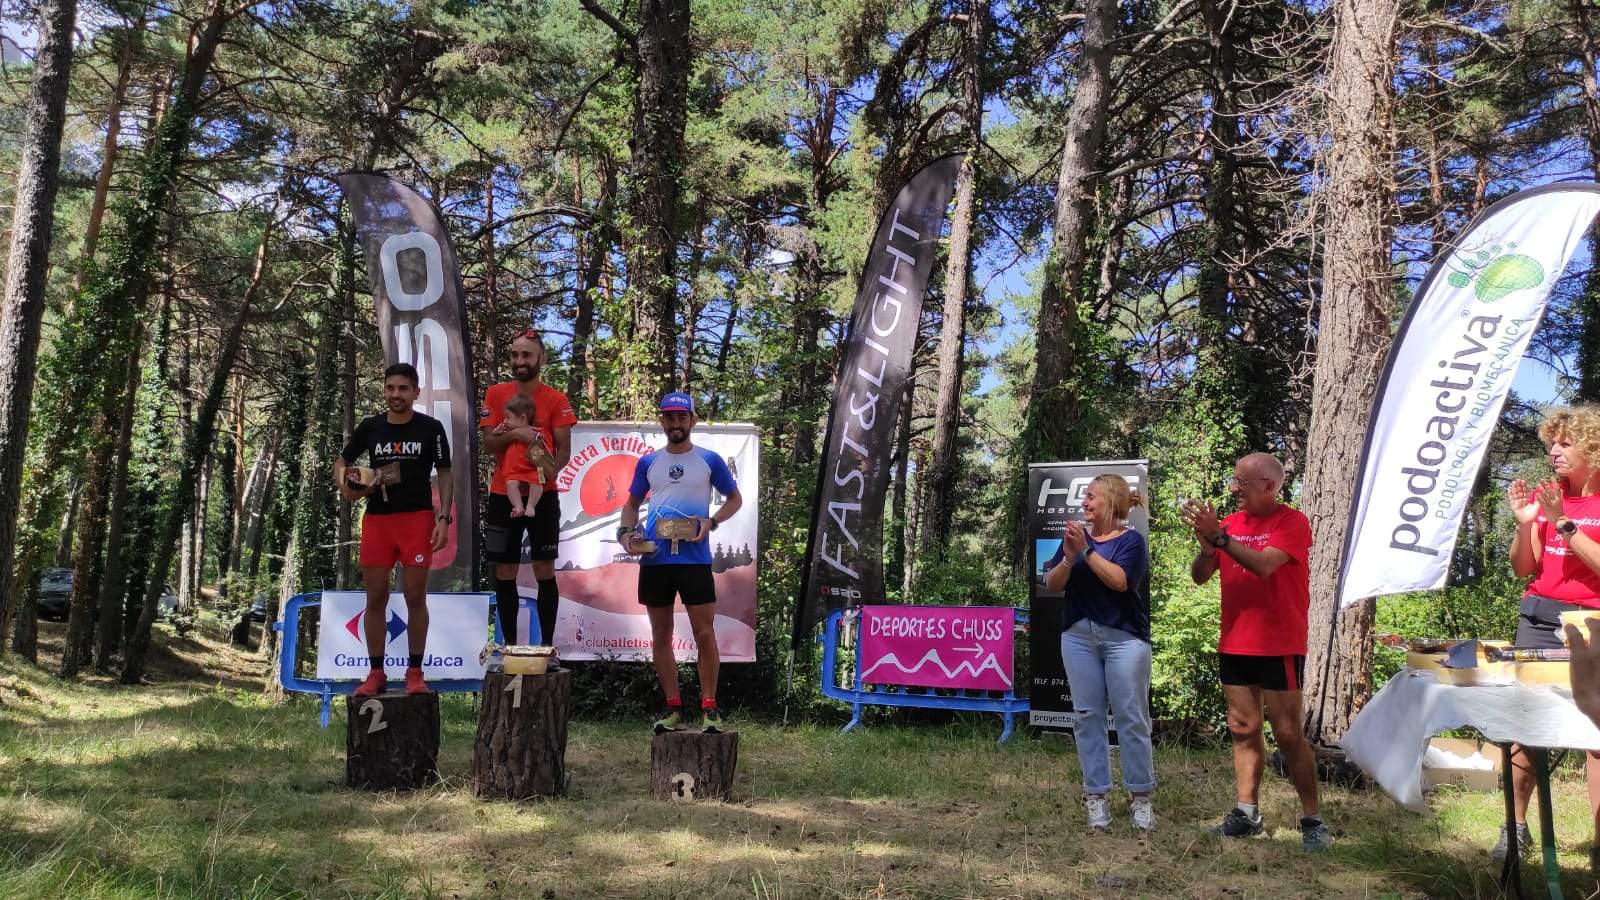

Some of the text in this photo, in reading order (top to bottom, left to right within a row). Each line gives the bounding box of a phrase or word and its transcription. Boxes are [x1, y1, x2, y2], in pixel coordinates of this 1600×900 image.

[821, 208, 920, 579] FAST&LIGHT
[374, 440, 422, 456] A4XKM
[600, 434, 655, 456] Vertica
[870, 616, 1003, 641] DEPORTES CHUSS
[423, 654, 464, 668] Jaca
[504, 674, 523, 708] 1
[359, 699, 389, 734] 2
[672, 772, 695, 800] 3
